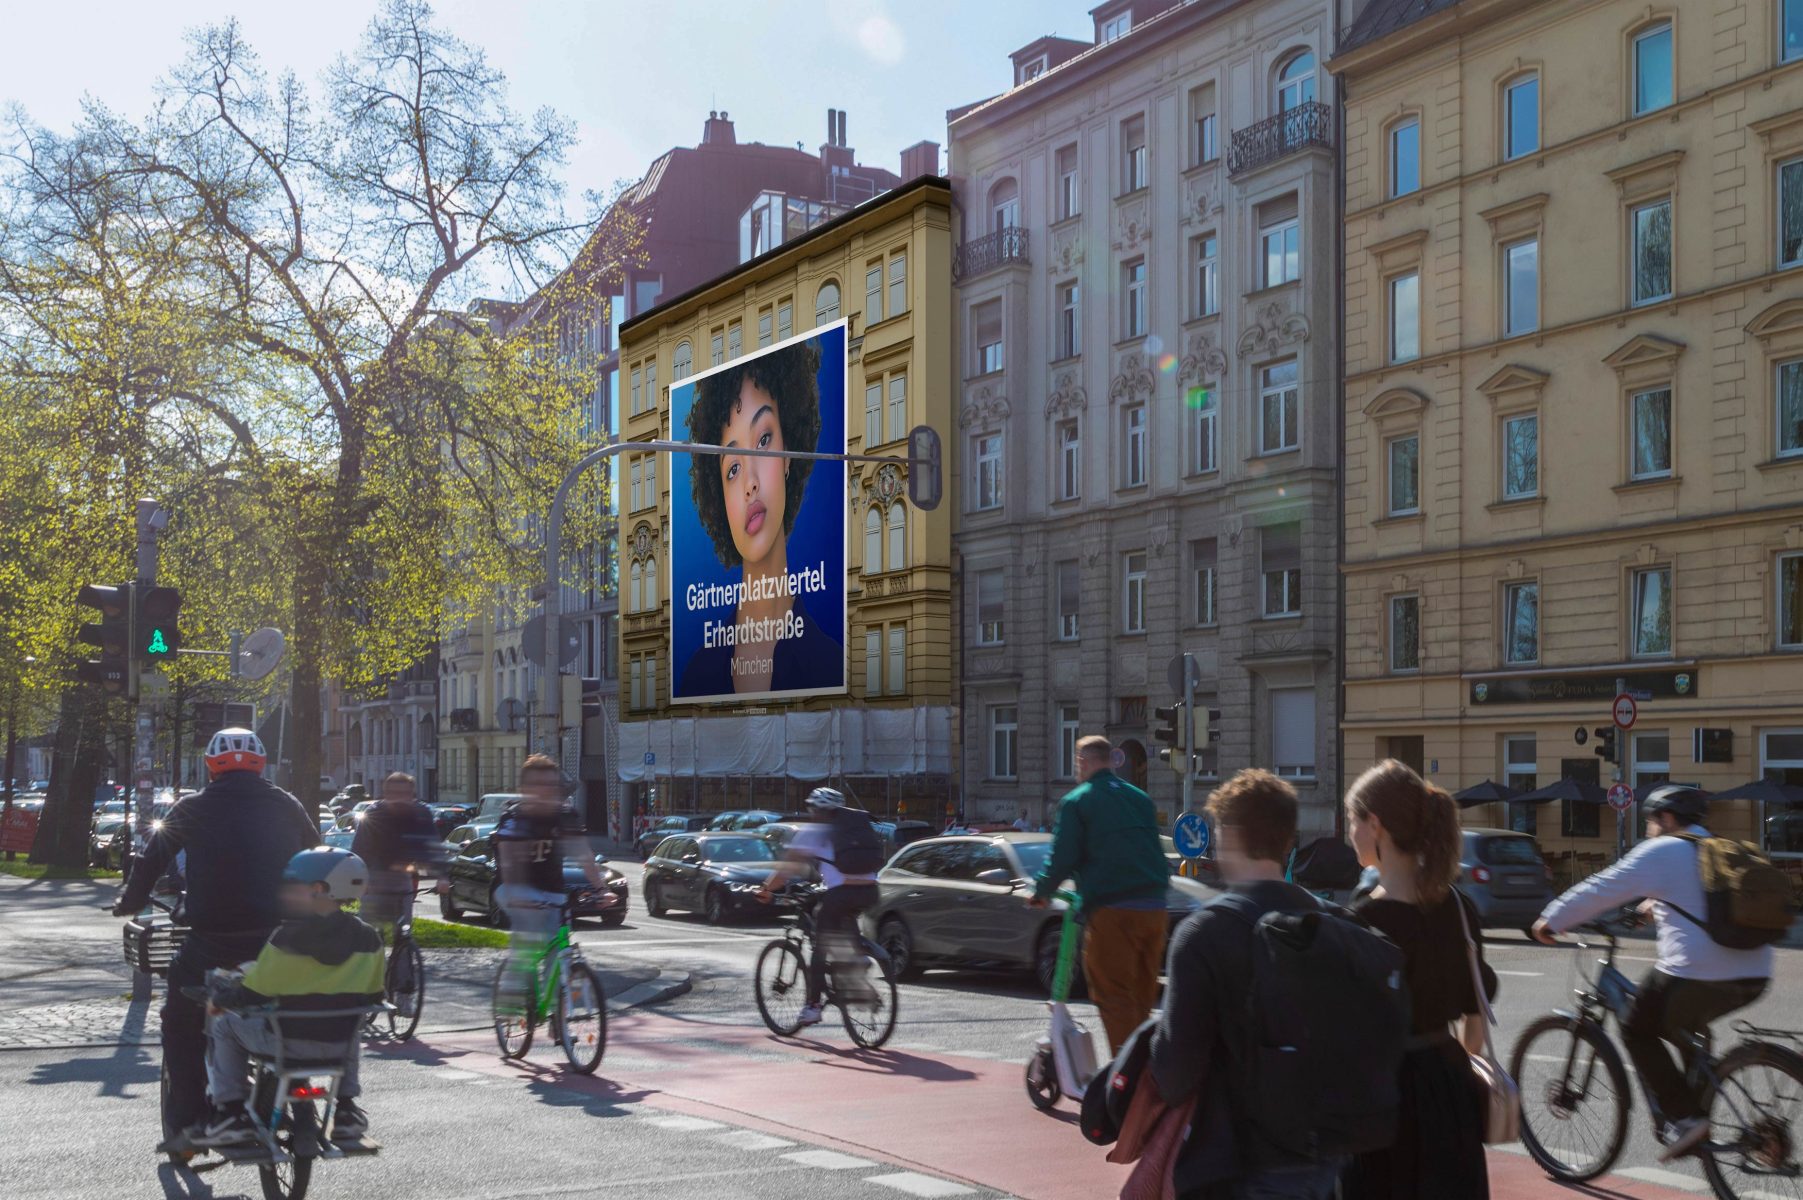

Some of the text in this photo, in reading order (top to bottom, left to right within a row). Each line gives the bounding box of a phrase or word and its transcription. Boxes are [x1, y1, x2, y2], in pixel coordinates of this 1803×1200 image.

[687, 561, 826, 610] Gärtnerplatzviertel
[704, 610, 804, 649] Erhardtstraße
[731, 656, 773, 676] München
